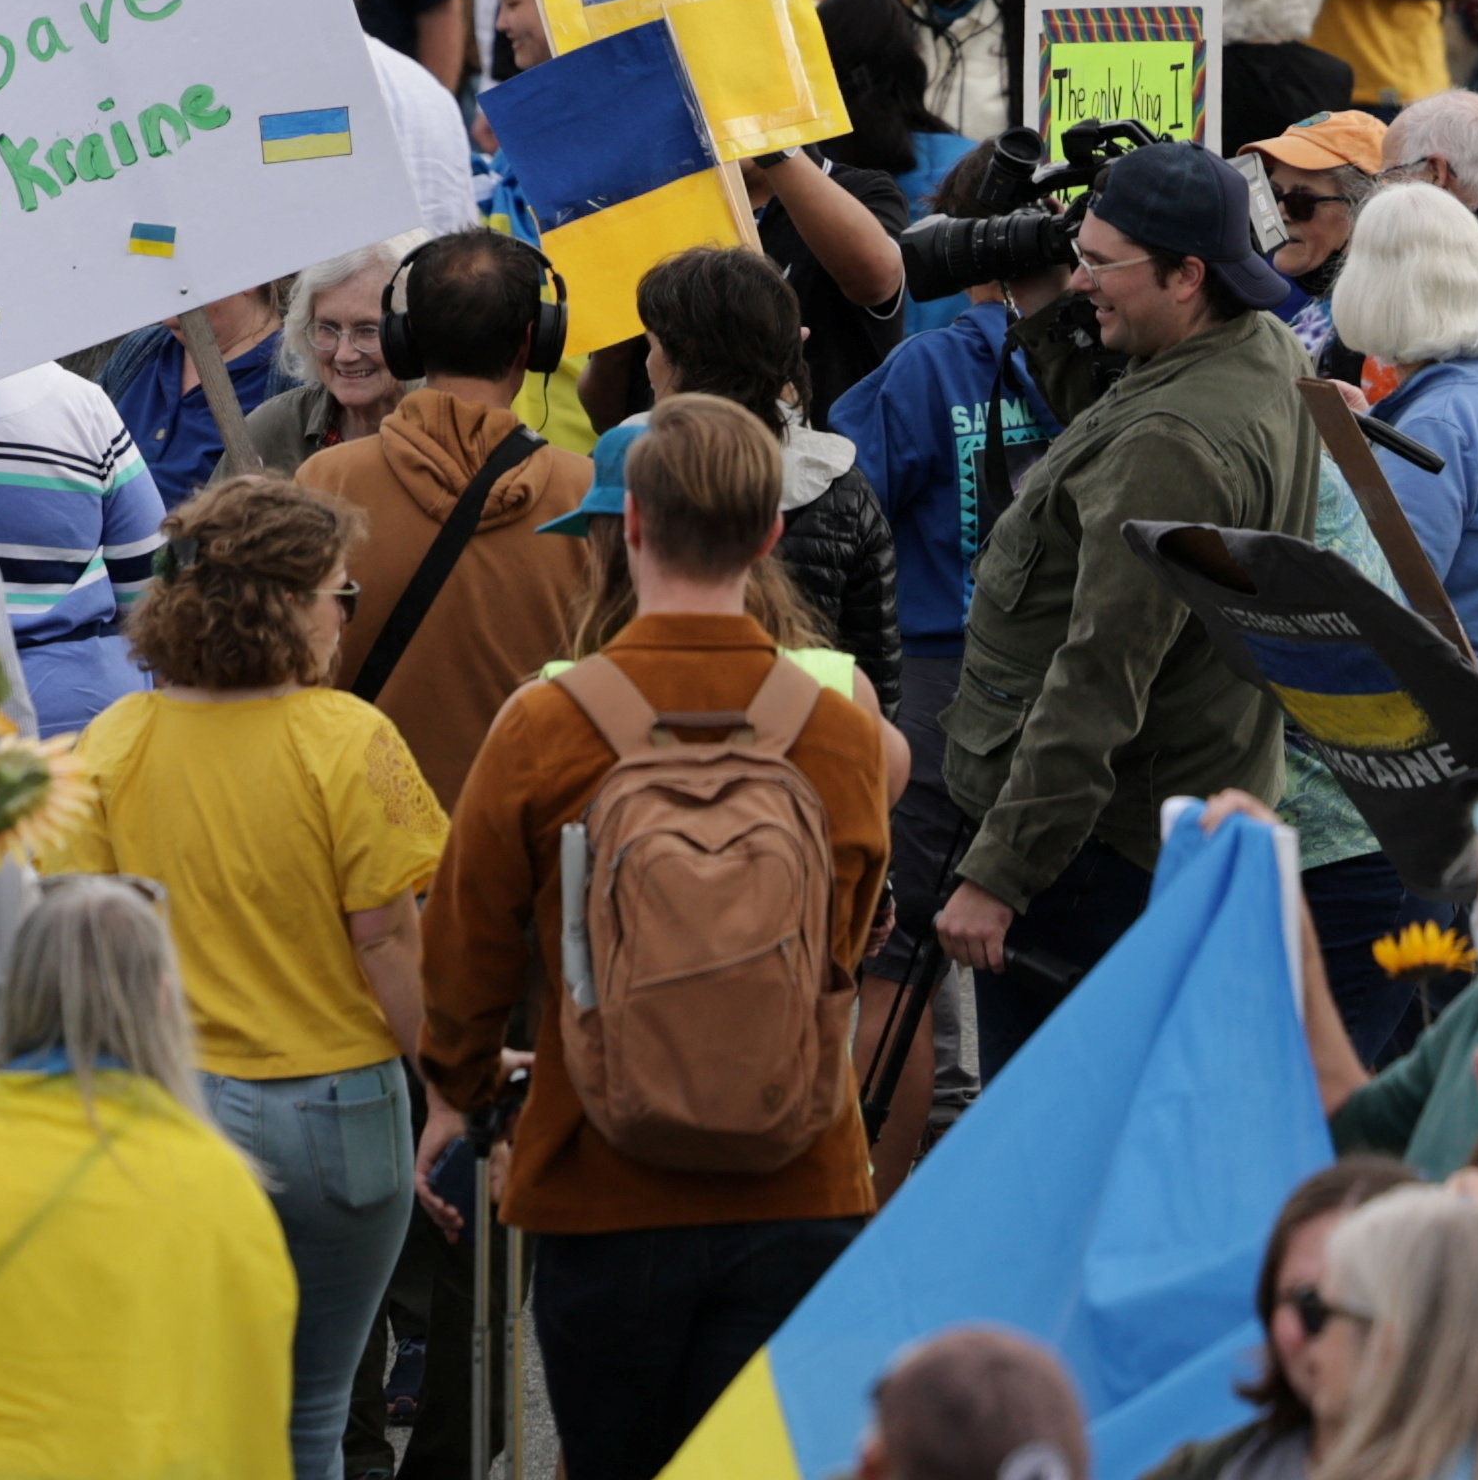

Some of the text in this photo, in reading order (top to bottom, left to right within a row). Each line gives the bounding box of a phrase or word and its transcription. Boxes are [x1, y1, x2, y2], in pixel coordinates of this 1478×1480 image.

[1052, 58, 1185, 136] The only King I
[1297, 611, 1362, 636] WITH
